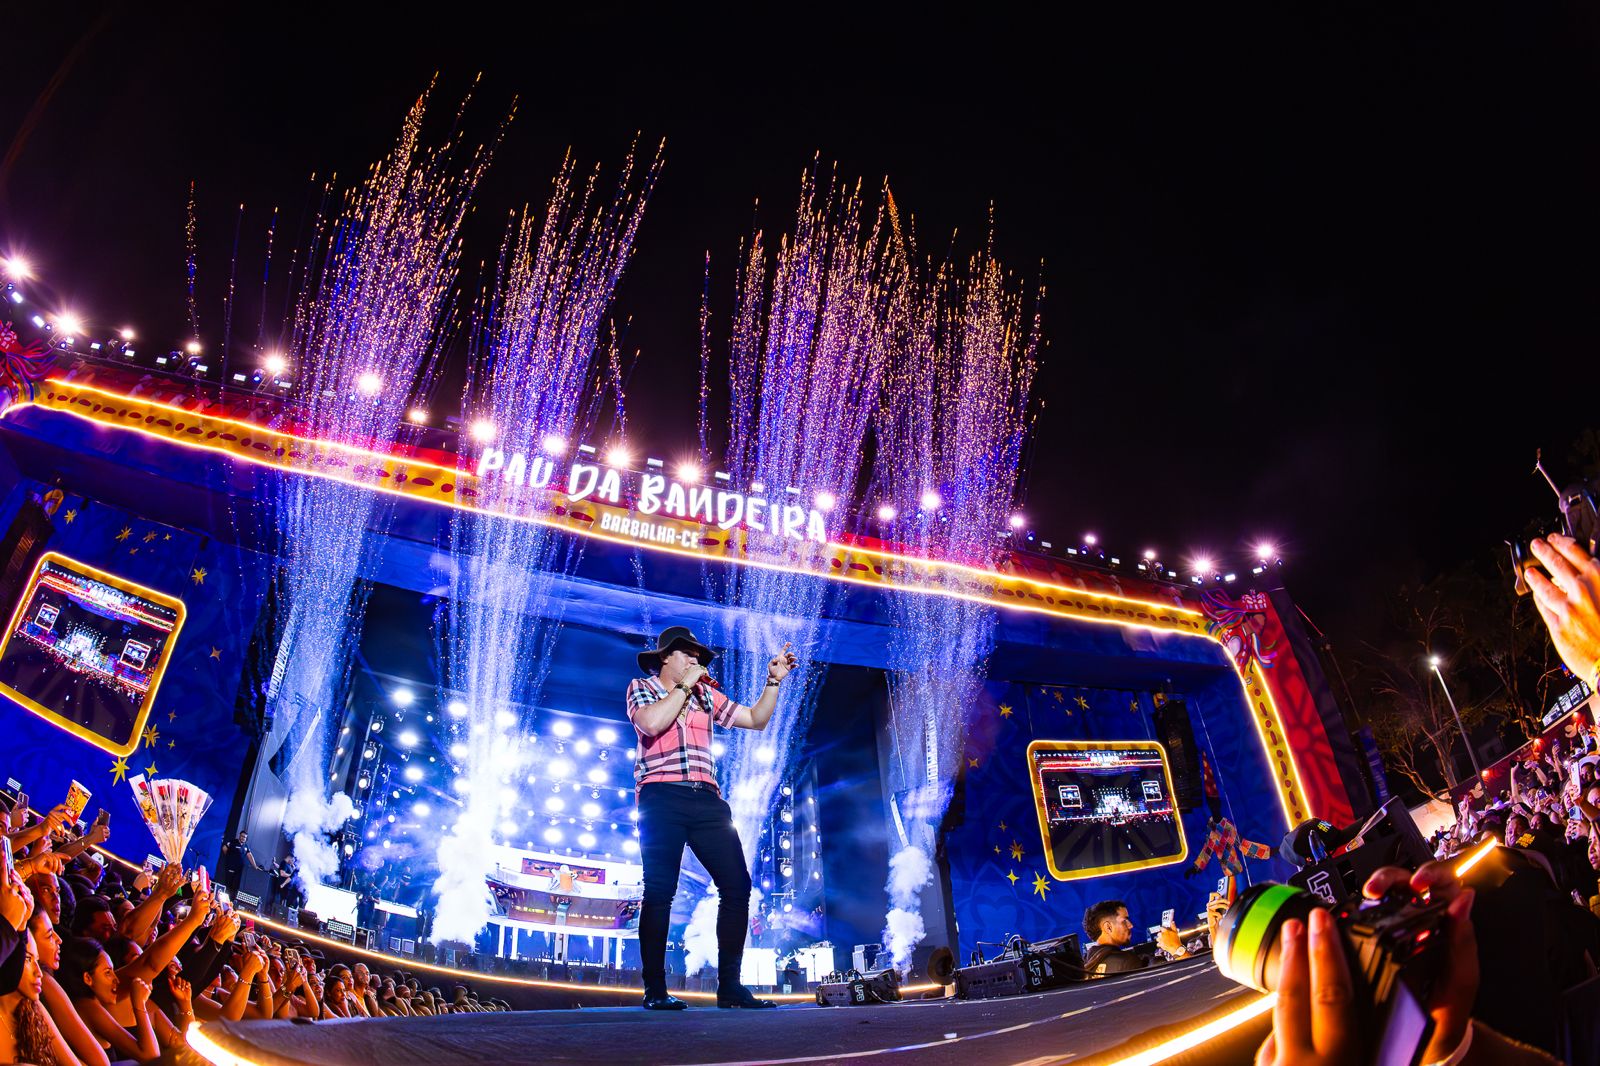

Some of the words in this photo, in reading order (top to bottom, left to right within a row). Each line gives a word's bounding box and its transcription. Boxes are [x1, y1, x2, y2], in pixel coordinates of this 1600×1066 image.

[476, 447, 554, 489] PAU
[567, 463, 621, 503] DA
[637, 473, 828, 544] BANDEIRA
[600, 512, 699, 549] BARBALHA-CE
